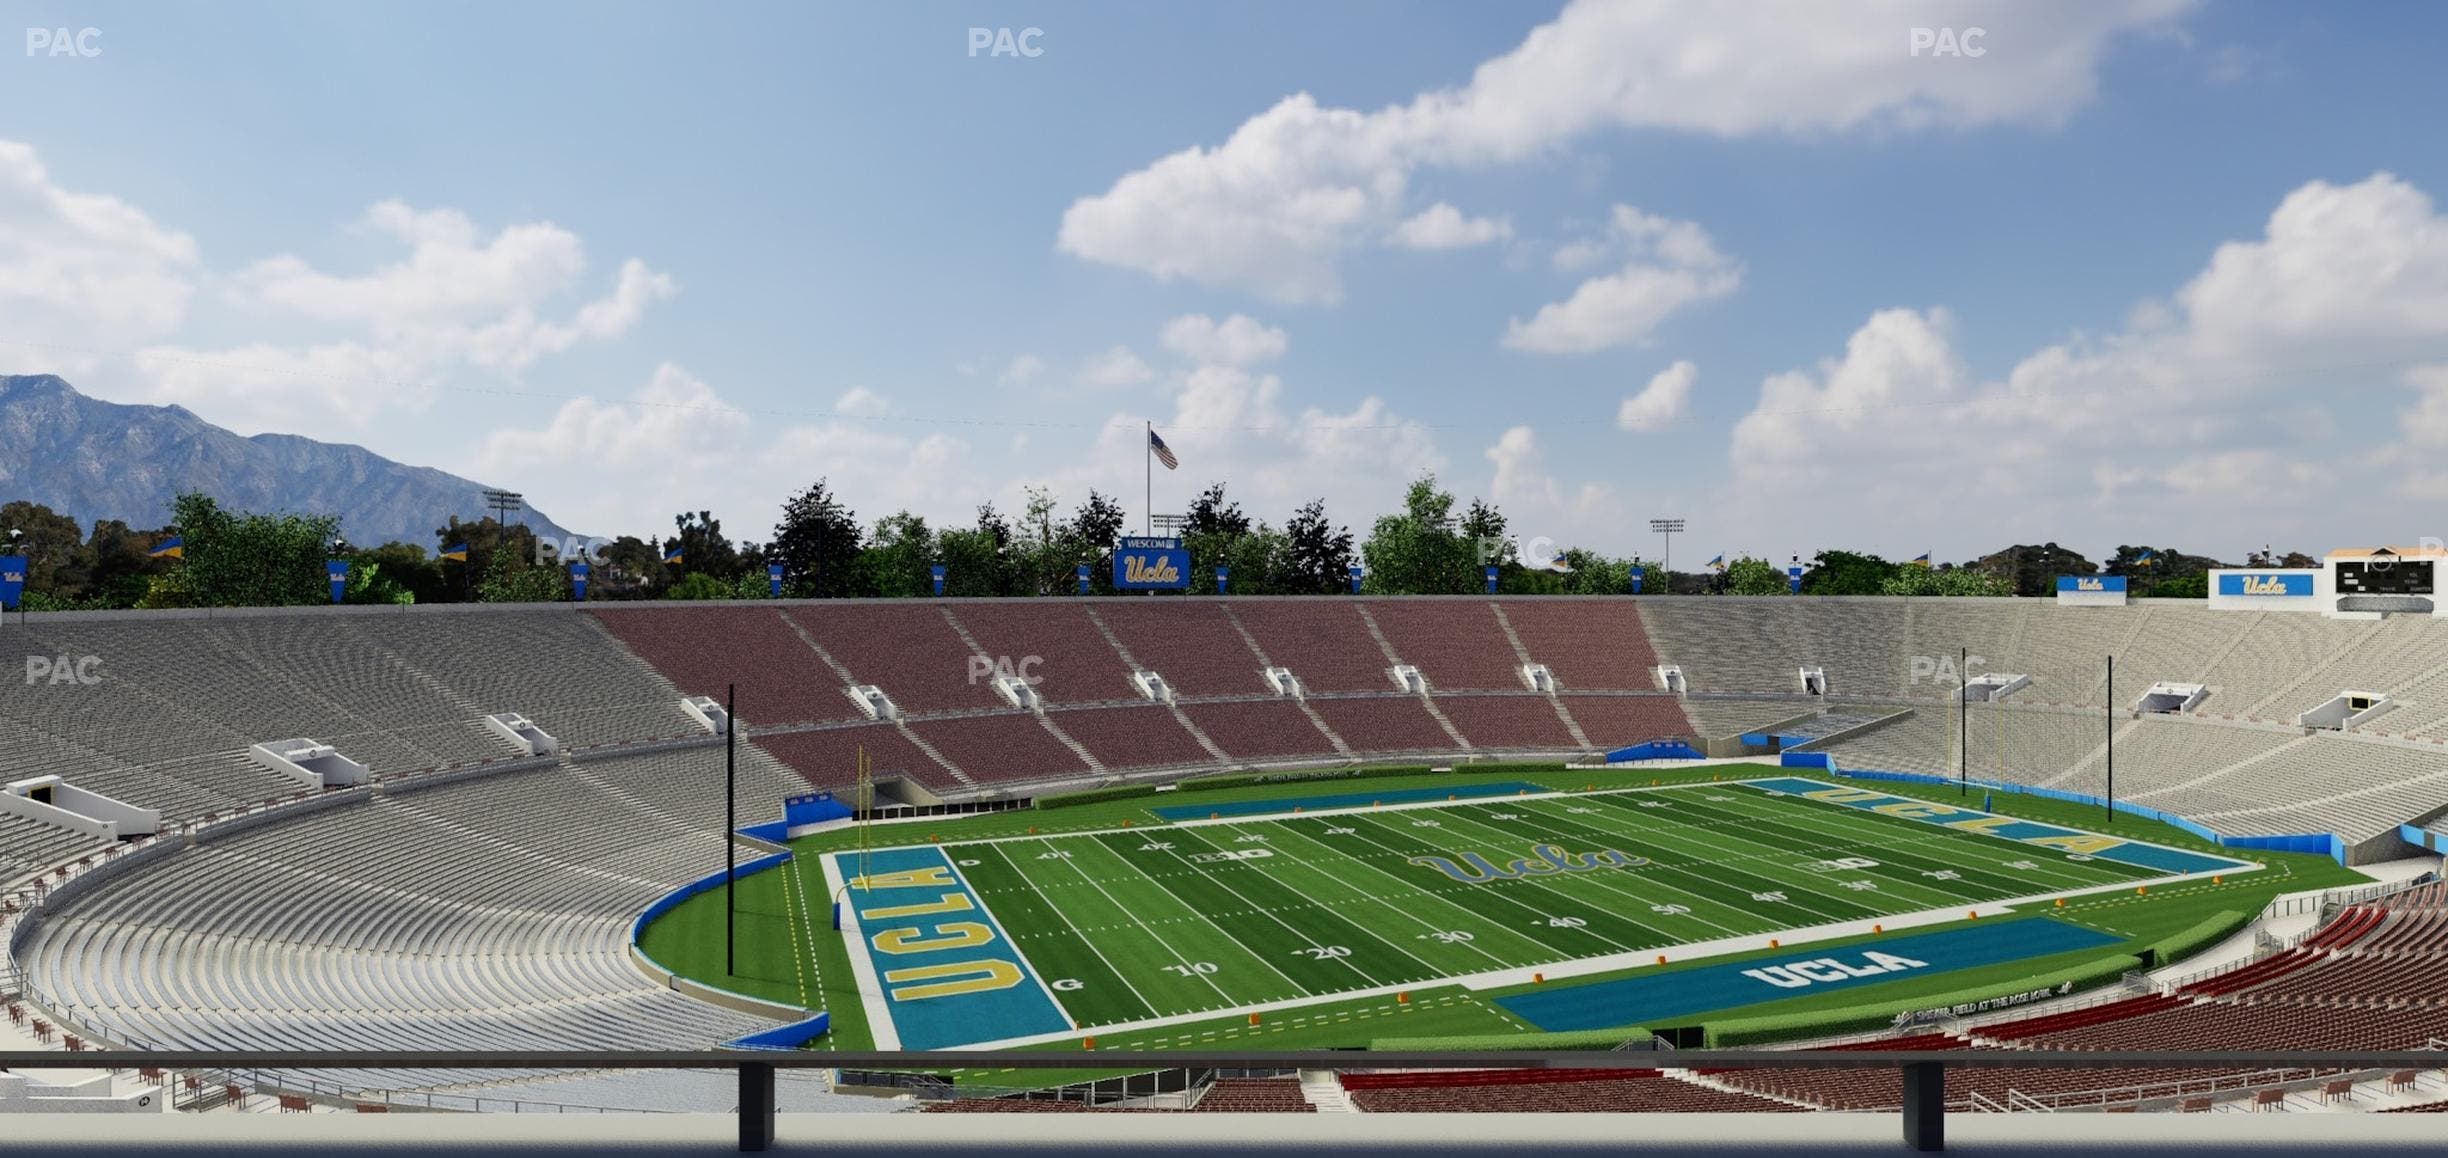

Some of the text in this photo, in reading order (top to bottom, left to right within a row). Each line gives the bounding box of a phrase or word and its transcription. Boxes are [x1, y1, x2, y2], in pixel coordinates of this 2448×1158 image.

[1127, 539, 1165, 549] WESCOM
[1124, 555, 1179, 583] Ucla
[2242, 575, 2286, 595] Ucla
[1802, 789, 2130, 854] UCLA
[1407, 843, 1650, 884] Ucla
[1651, 904, 1692, 915] 50
[1550, 916, 1587, 927] 40
[849, 866, 1026, 1001] UCLA
[1431, 930, 1474, 943] 30
[1306, 945, 1352, 960] 20
[1172, 962, 1218, 976] 10
[1740, 951, 1930, 988] UCLA
[1051, 978, 1084, 991] G
[1953, 1003, 1976, 1015] FIELD
[1978, 1000, 1989, 1011] AT
[1991, 996, 2008, 1008] THE
[2010, 992, 2029, 1005] ROSE
